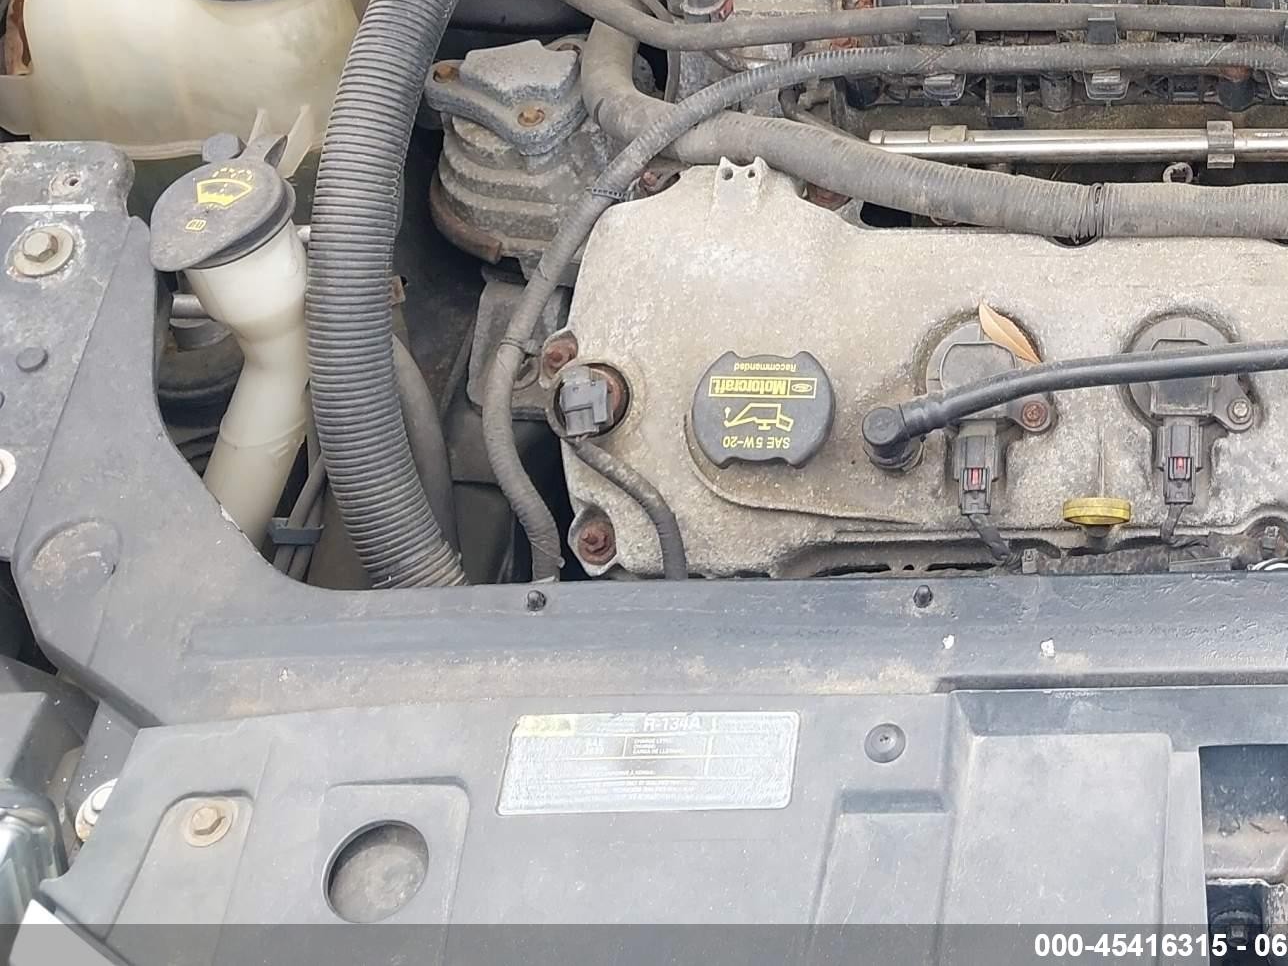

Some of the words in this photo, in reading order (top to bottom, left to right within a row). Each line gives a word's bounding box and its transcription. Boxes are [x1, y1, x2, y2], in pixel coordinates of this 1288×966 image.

[734, 362, 797, 374] Recommended
[715, 379, 787, 395] Motorcraft
[722, 435, 764, 448] 5W-20
[766, 436, 791, 449] SAE
[643, 717, 702, 732] R-134A
